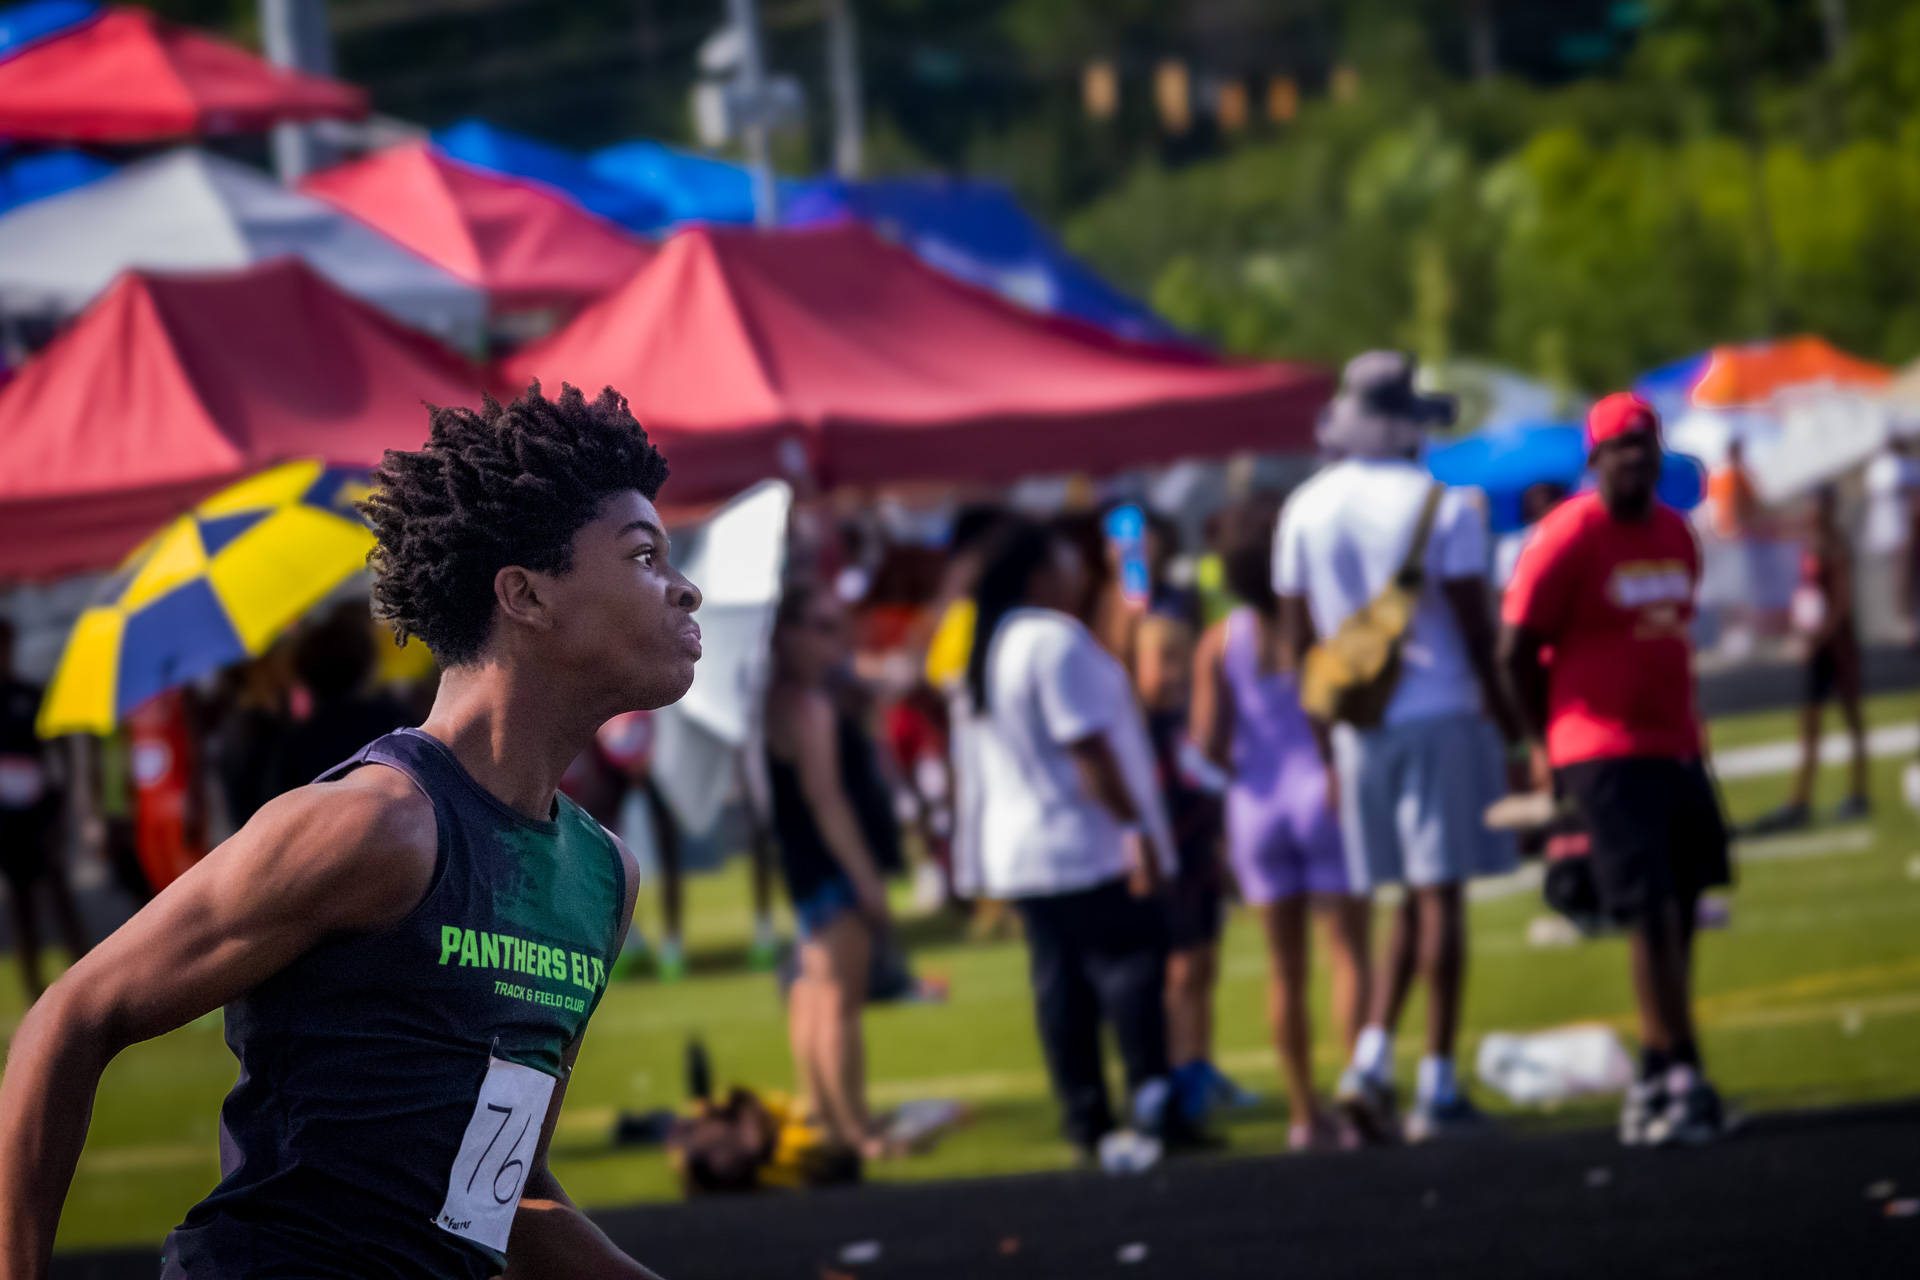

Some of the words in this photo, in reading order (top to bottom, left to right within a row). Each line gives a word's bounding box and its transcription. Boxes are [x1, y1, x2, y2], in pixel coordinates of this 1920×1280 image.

[438, 925, 567, 981] PANTHERS
[494, 981, 526, 1000] TRACK
[526, 988, 533, 1001] &
[534, 990, 563, 1007] FIELD
[564, 996, 585, 1013] CLUB
[467, 1103, 532, 1206] 76
